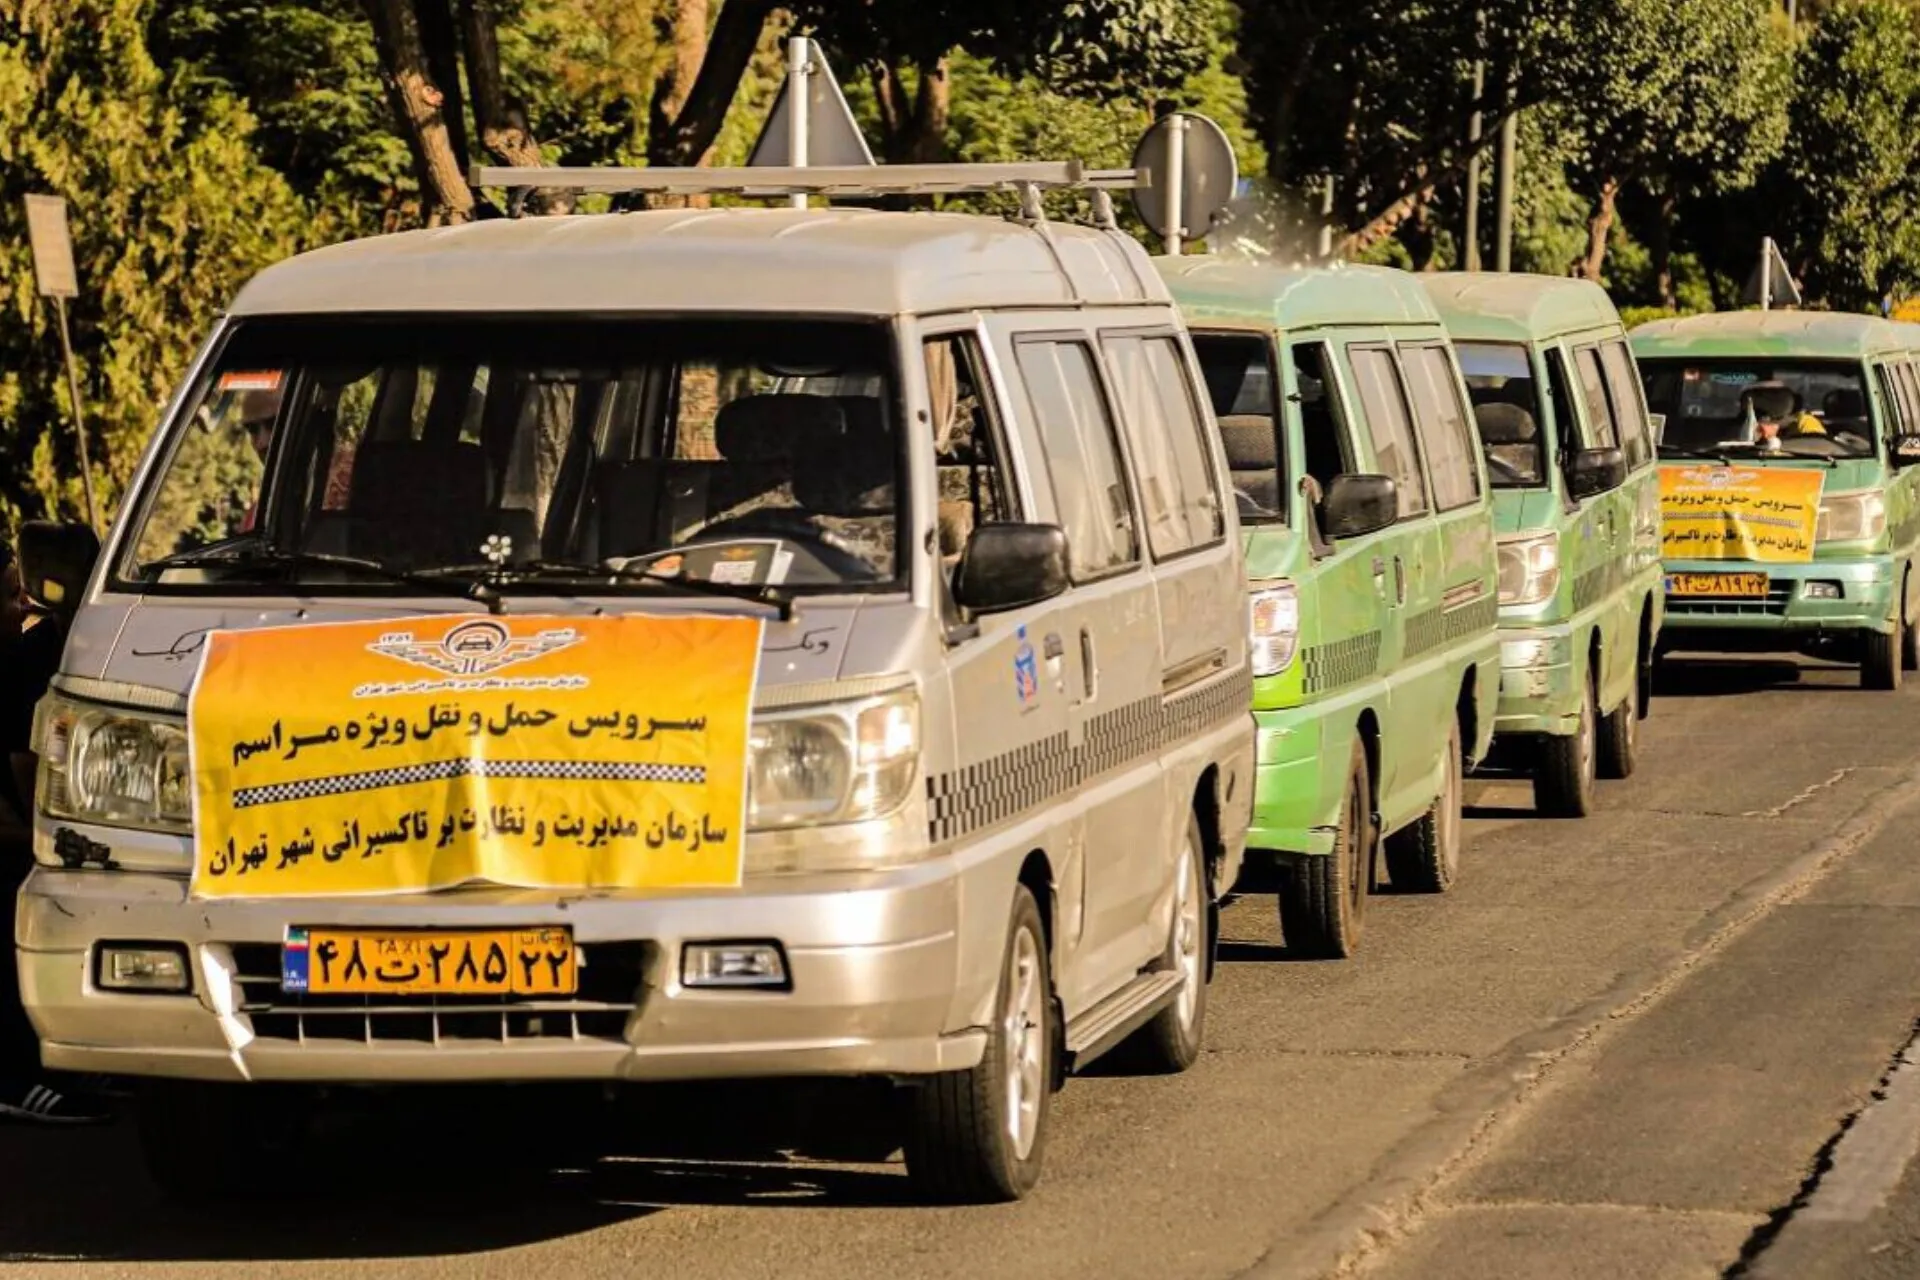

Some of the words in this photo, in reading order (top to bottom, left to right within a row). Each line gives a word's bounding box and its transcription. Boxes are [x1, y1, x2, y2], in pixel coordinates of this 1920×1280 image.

[1672, 494, 1695, 506] ویژه
[1697, 493, 1715, 505] نقل
[1724, 493, 1750, 505] حمل
[1753, 499, 1803, 511] سرویس
[1777, 536, 1808, 552] سازمان
[345, 711, 407, 750] ویژه
[412, 702, 462, 740] نقل
[464, 709, 482, 736] و
[488, 701, 557, 736] حمل
[568, 709, 706, 740] سرویس
[232, 719, 340, 768] مراسم
[322, 810, 428, 862] تاکسیرانی
[436, 810, 456, 848] بر
[459, 804, 526, 840] نظارت
[533, 818, 545, 846] و
[553, 812, 638, 847] مدیریت
[645, 811, 727, 851] سازمان
[209, 833, 269, 876] تهران
[276, 827, 315, 869] شهر
[376, 938, 422, 956] TAXI
